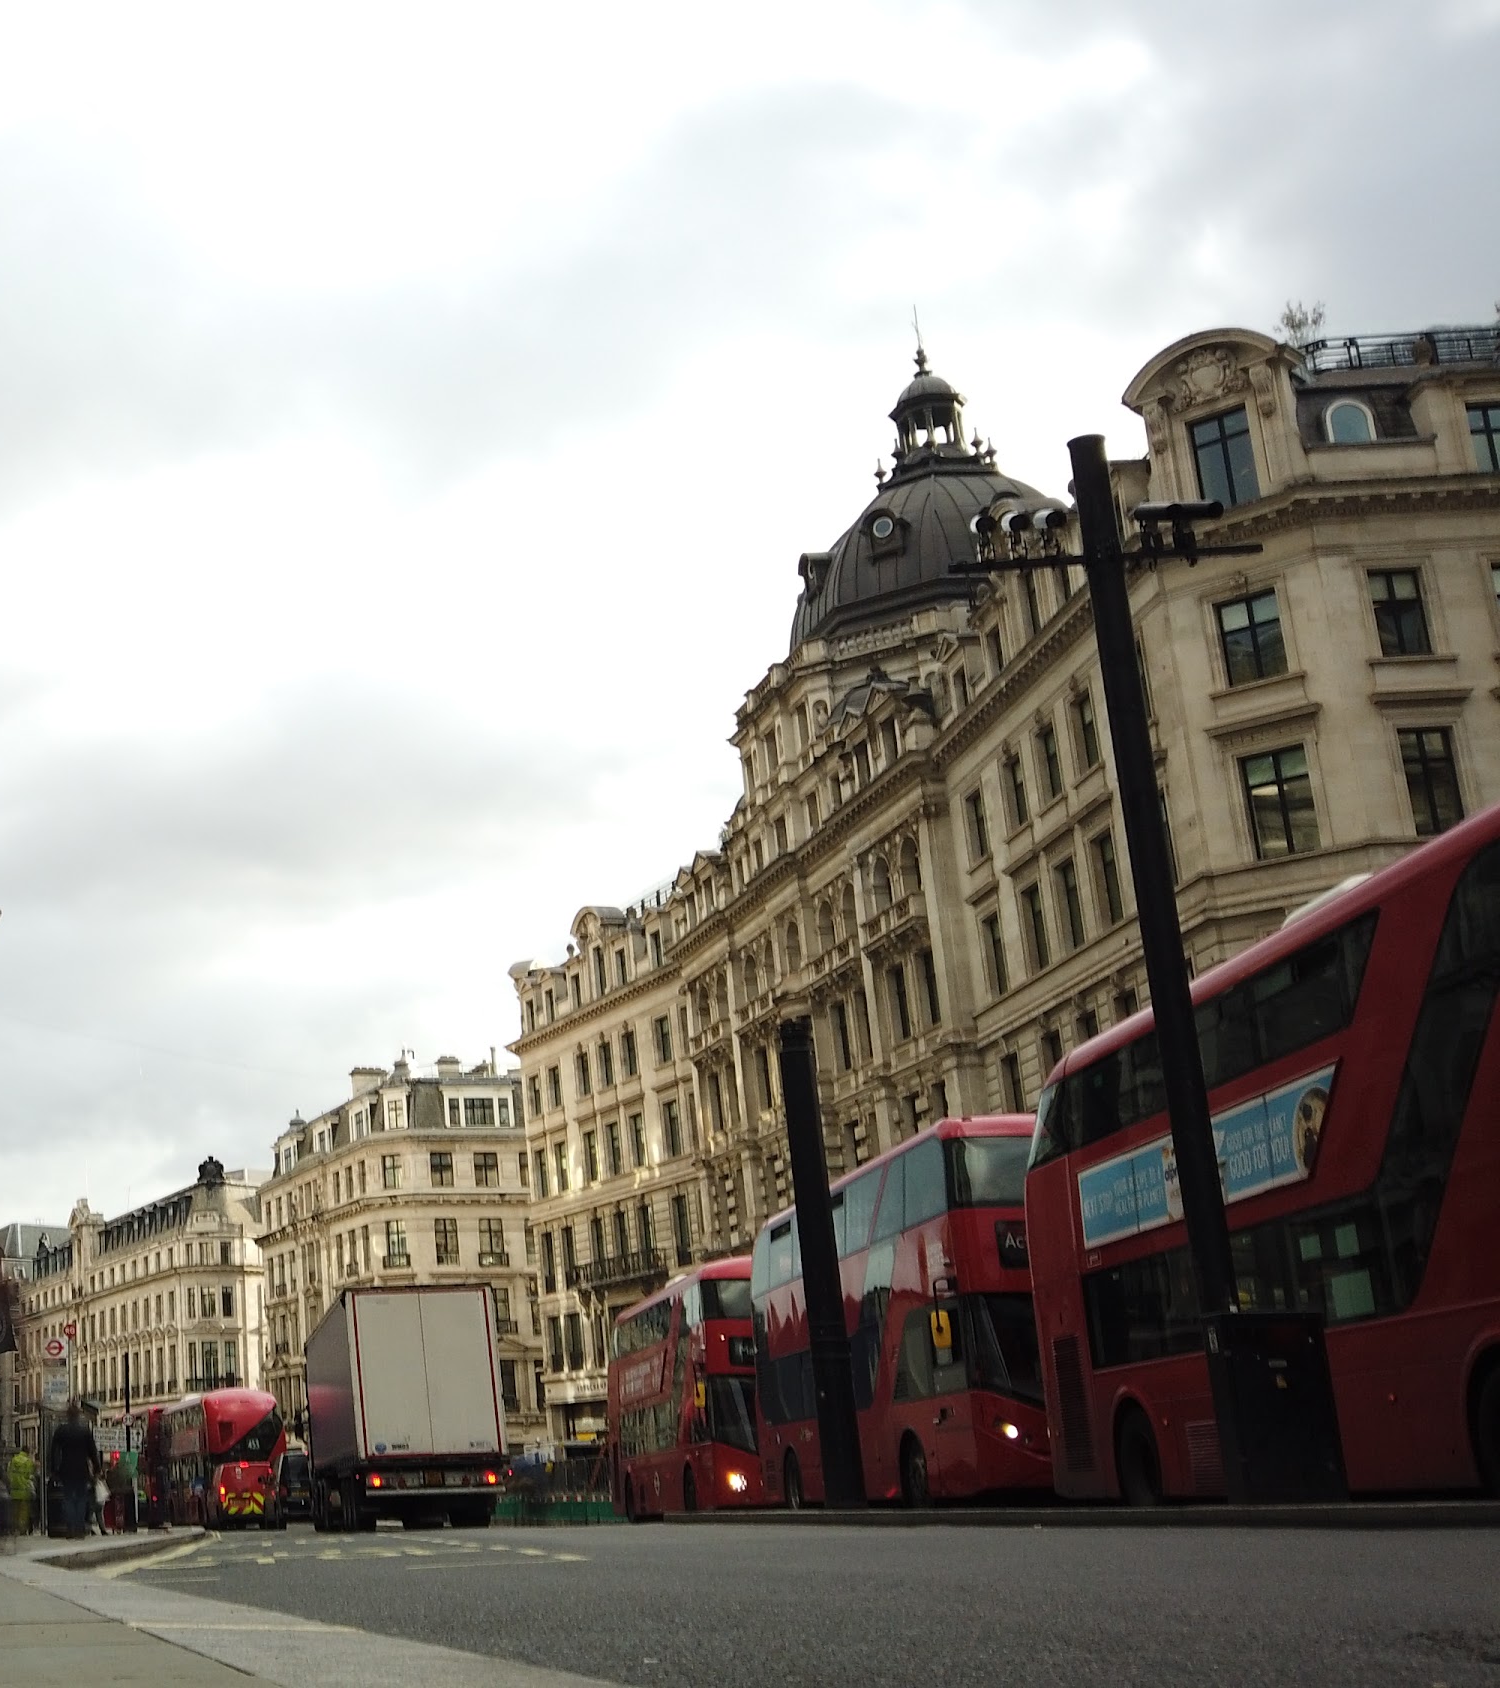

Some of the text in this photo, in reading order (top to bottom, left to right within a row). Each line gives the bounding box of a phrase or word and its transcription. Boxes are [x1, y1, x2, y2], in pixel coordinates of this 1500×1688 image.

[1229, 1150, 1252, 1180] GOOD
[1252, 1143, 1269, 1172] FOR
[1004, 1231, 1027, 1249] Ac
